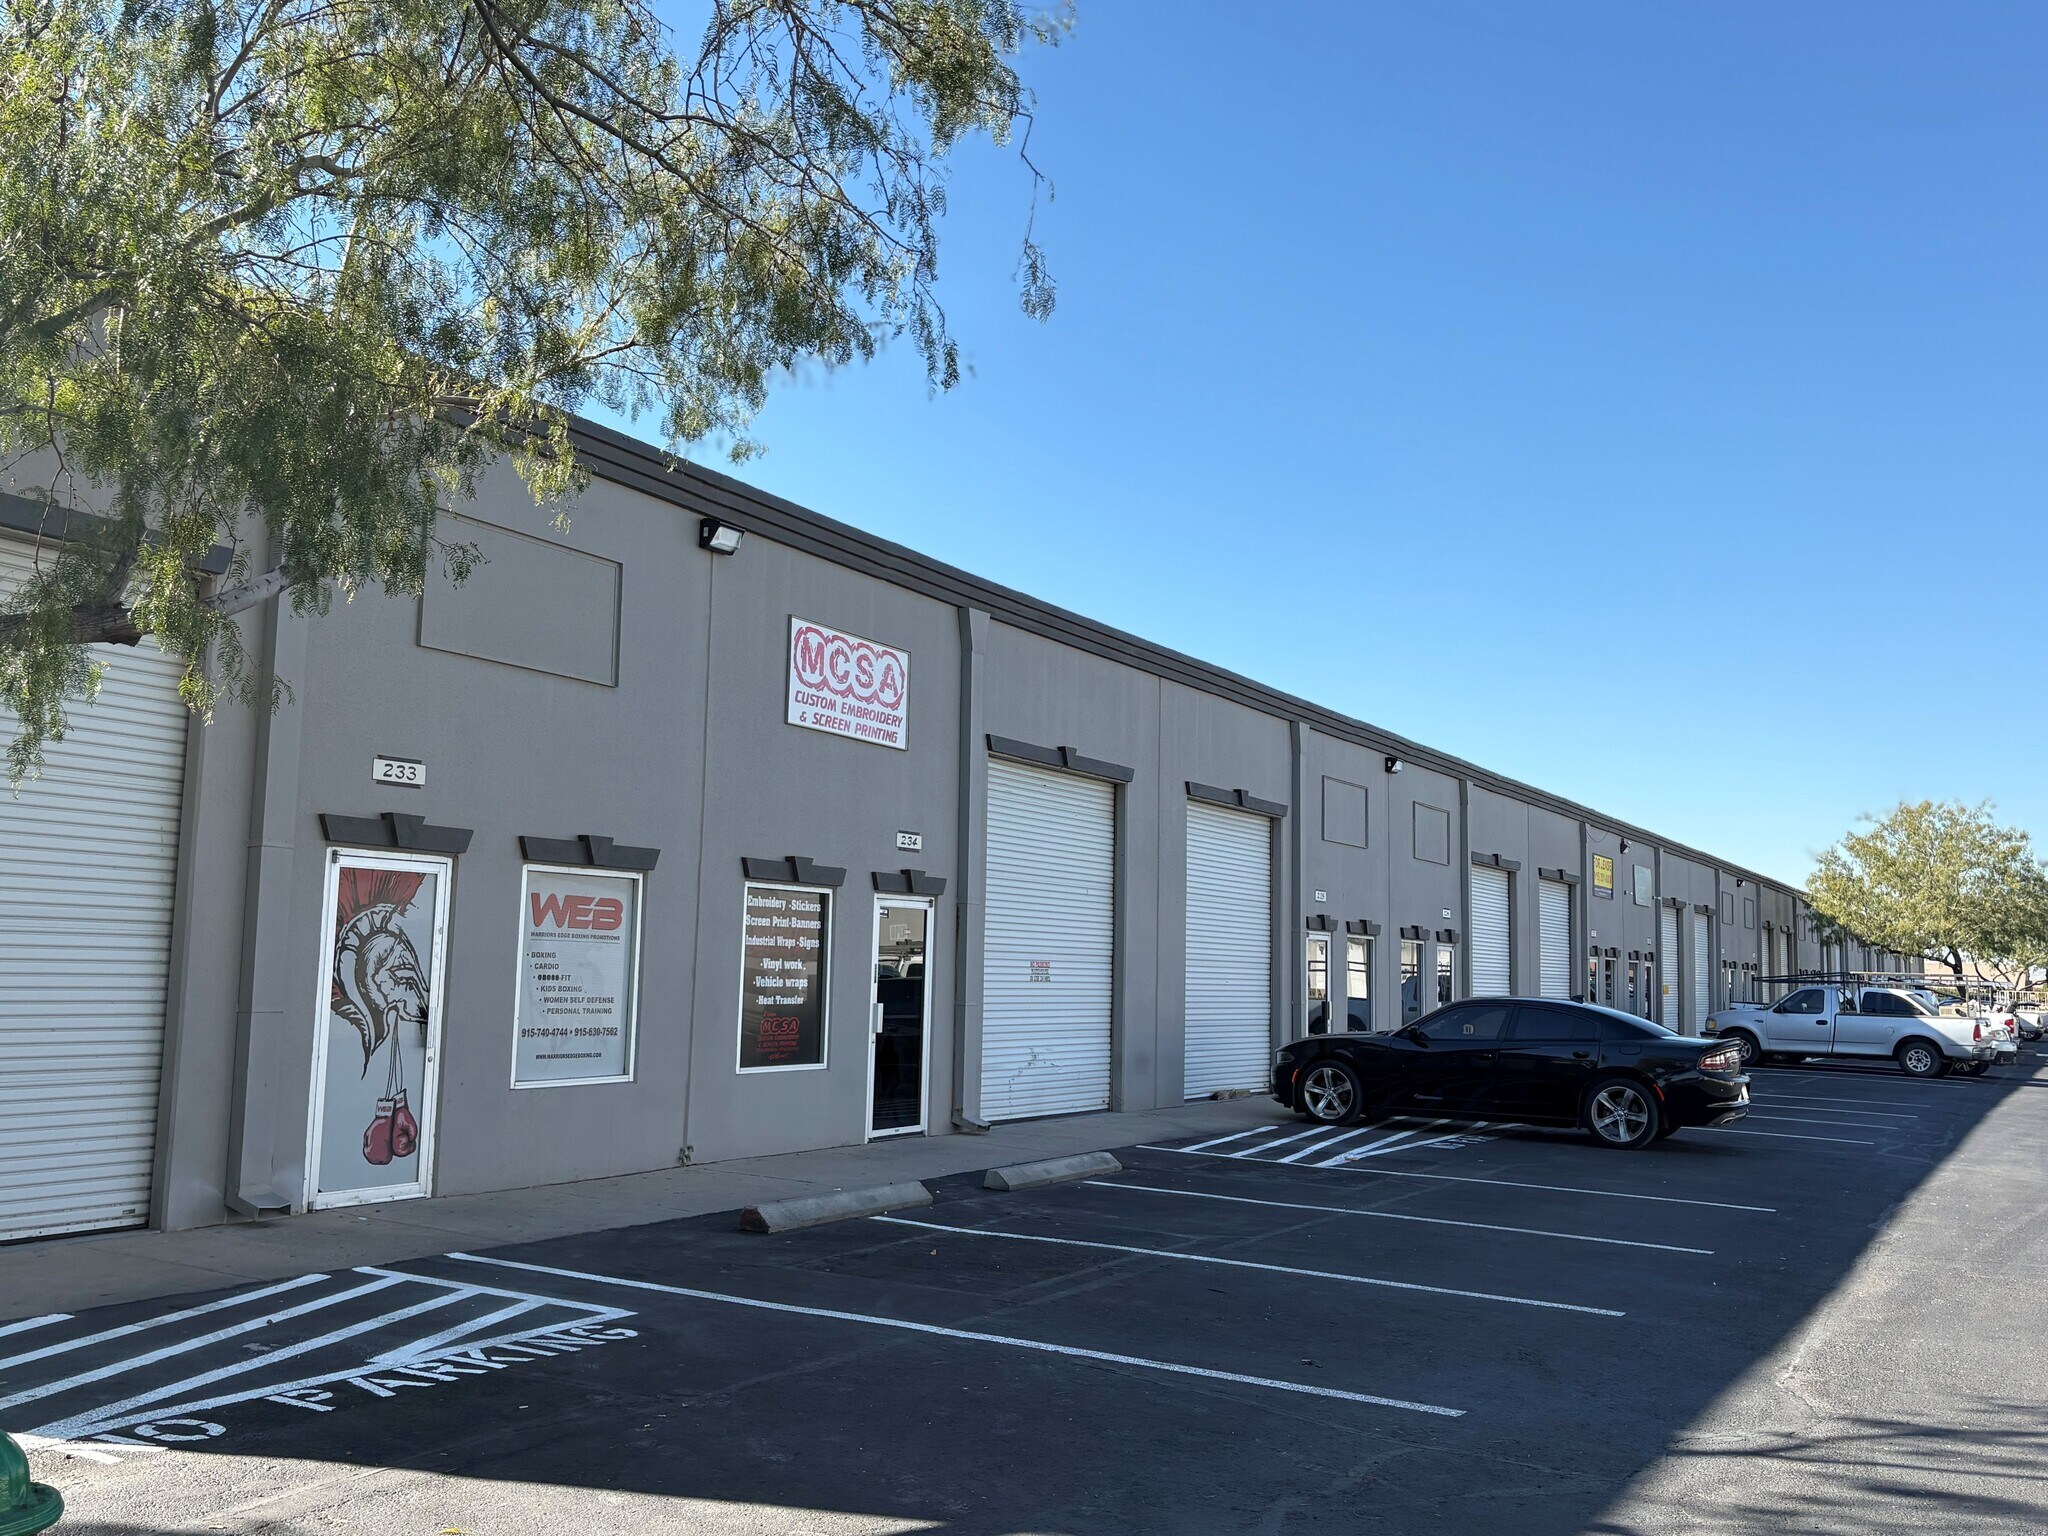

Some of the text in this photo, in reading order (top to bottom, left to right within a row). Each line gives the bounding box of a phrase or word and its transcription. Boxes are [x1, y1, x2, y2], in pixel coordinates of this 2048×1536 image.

[800, 636, 899, 698] MCSA
[794, 690, 903, 728] CUSTOM EMBROIDERY
[799, 711, 898, 744] & SCREEN PRINTING
[382, 763, 417, 781] 233
[900, 835, 918, 847] 234
[747, 894, 821, 912] Embroidery Stickers
[530, 892, 624, 931] WEB
[745, 914, 771, 926] Screen
[745, 934, 820, 950] Industrial Wraps Signs
[531, 951, 557, 959] BOXING
[763, 957, 783, 972] Vinyl
[540, 985, 583, 993] KIDS BOXING
[755, 975, 809, 990] Vehicle wraps
[543, 996, 615, 1004] WOMEN SELF DEFENSE
[758, 994, 804, 1005] Heat Transfer
[546, 1007, 613, 1015] PERSONAL TRAINING
[521, 1028, 568, 1038] 915-740-4744
